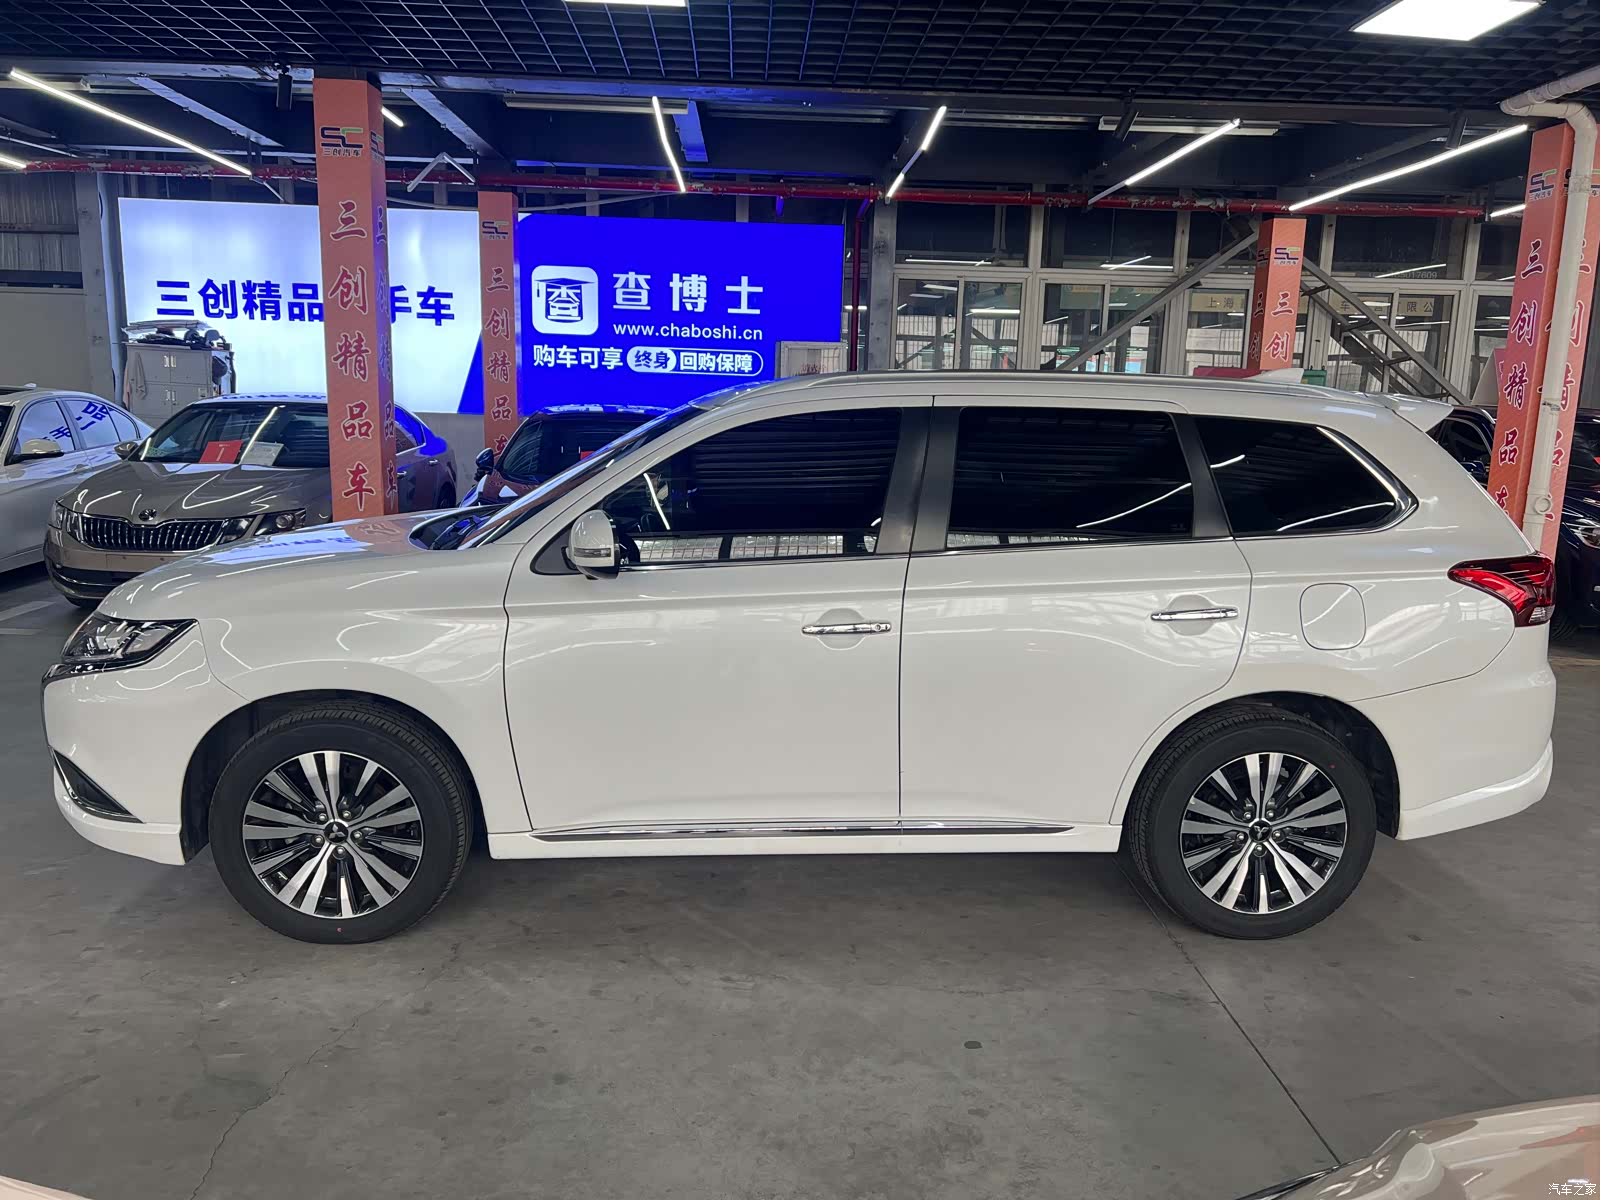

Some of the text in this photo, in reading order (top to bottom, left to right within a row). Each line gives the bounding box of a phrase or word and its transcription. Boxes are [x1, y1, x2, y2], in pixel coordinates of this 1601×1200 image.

[156, 278, 455, 326] 三创精品手车
[612, 271, 764, 315] 查博士
[612, 322, 763, 341] www.chaboshi.cn
[1265, 291, 1294, 362] 三创
[329, 200, 376, 511] 三创精品车
[533, 344, 753, 373] 购车可享 终身 回购保障
